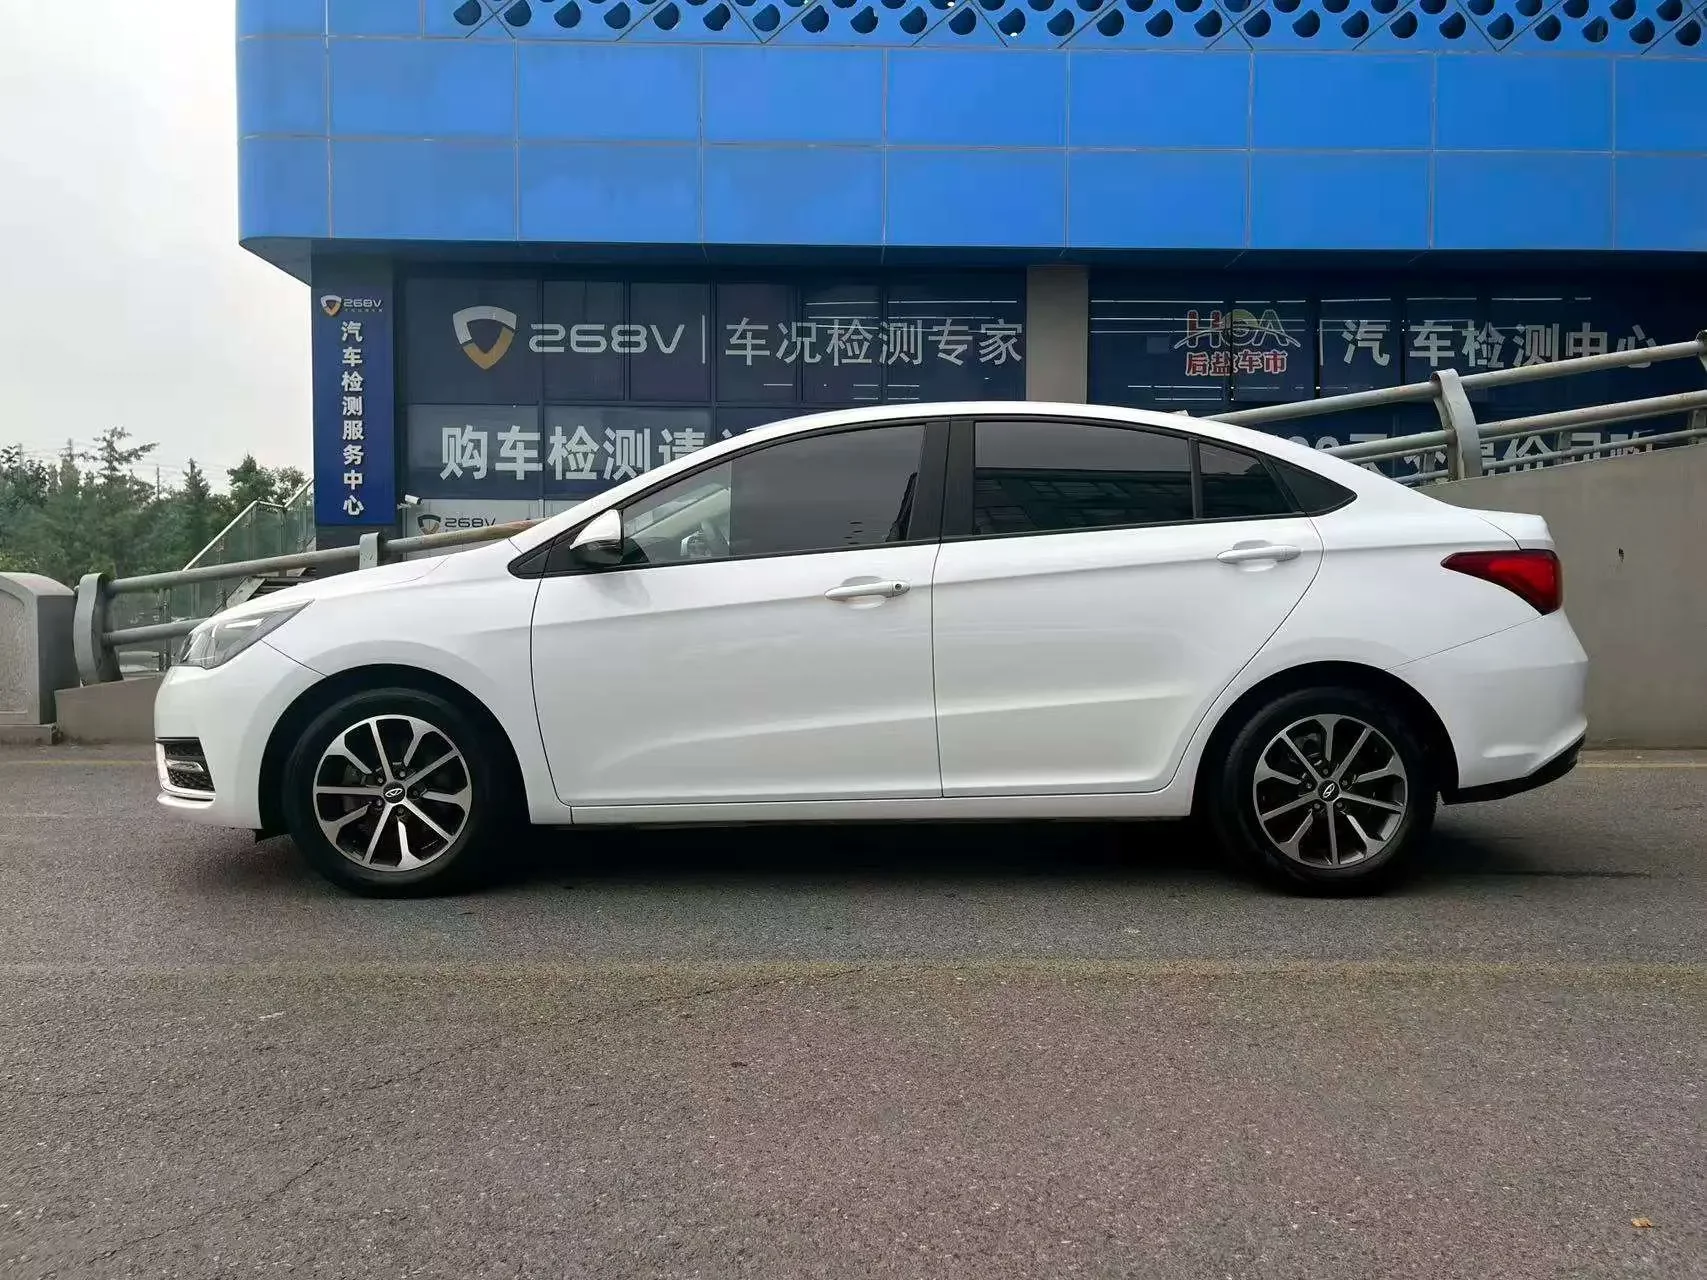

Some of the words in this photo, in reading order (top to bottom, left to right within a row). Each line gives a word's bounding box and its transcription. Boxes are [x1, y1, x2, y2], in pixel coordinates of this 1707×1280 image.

[343, 298, 382, 308] 268V
[528, 322, 685, 354] 268V
[725, 317, 1023, 366] 车况检测专家
[1185, 349, 1288, 376] 后盐车市
[1342, 319, 1658, 369] 汽车检测中心
[341, 320, 364, 517] 汽车检测服务中心
[439, 424, 733, 481] 购车检测请
[444, 517, 496, 528] 268V
